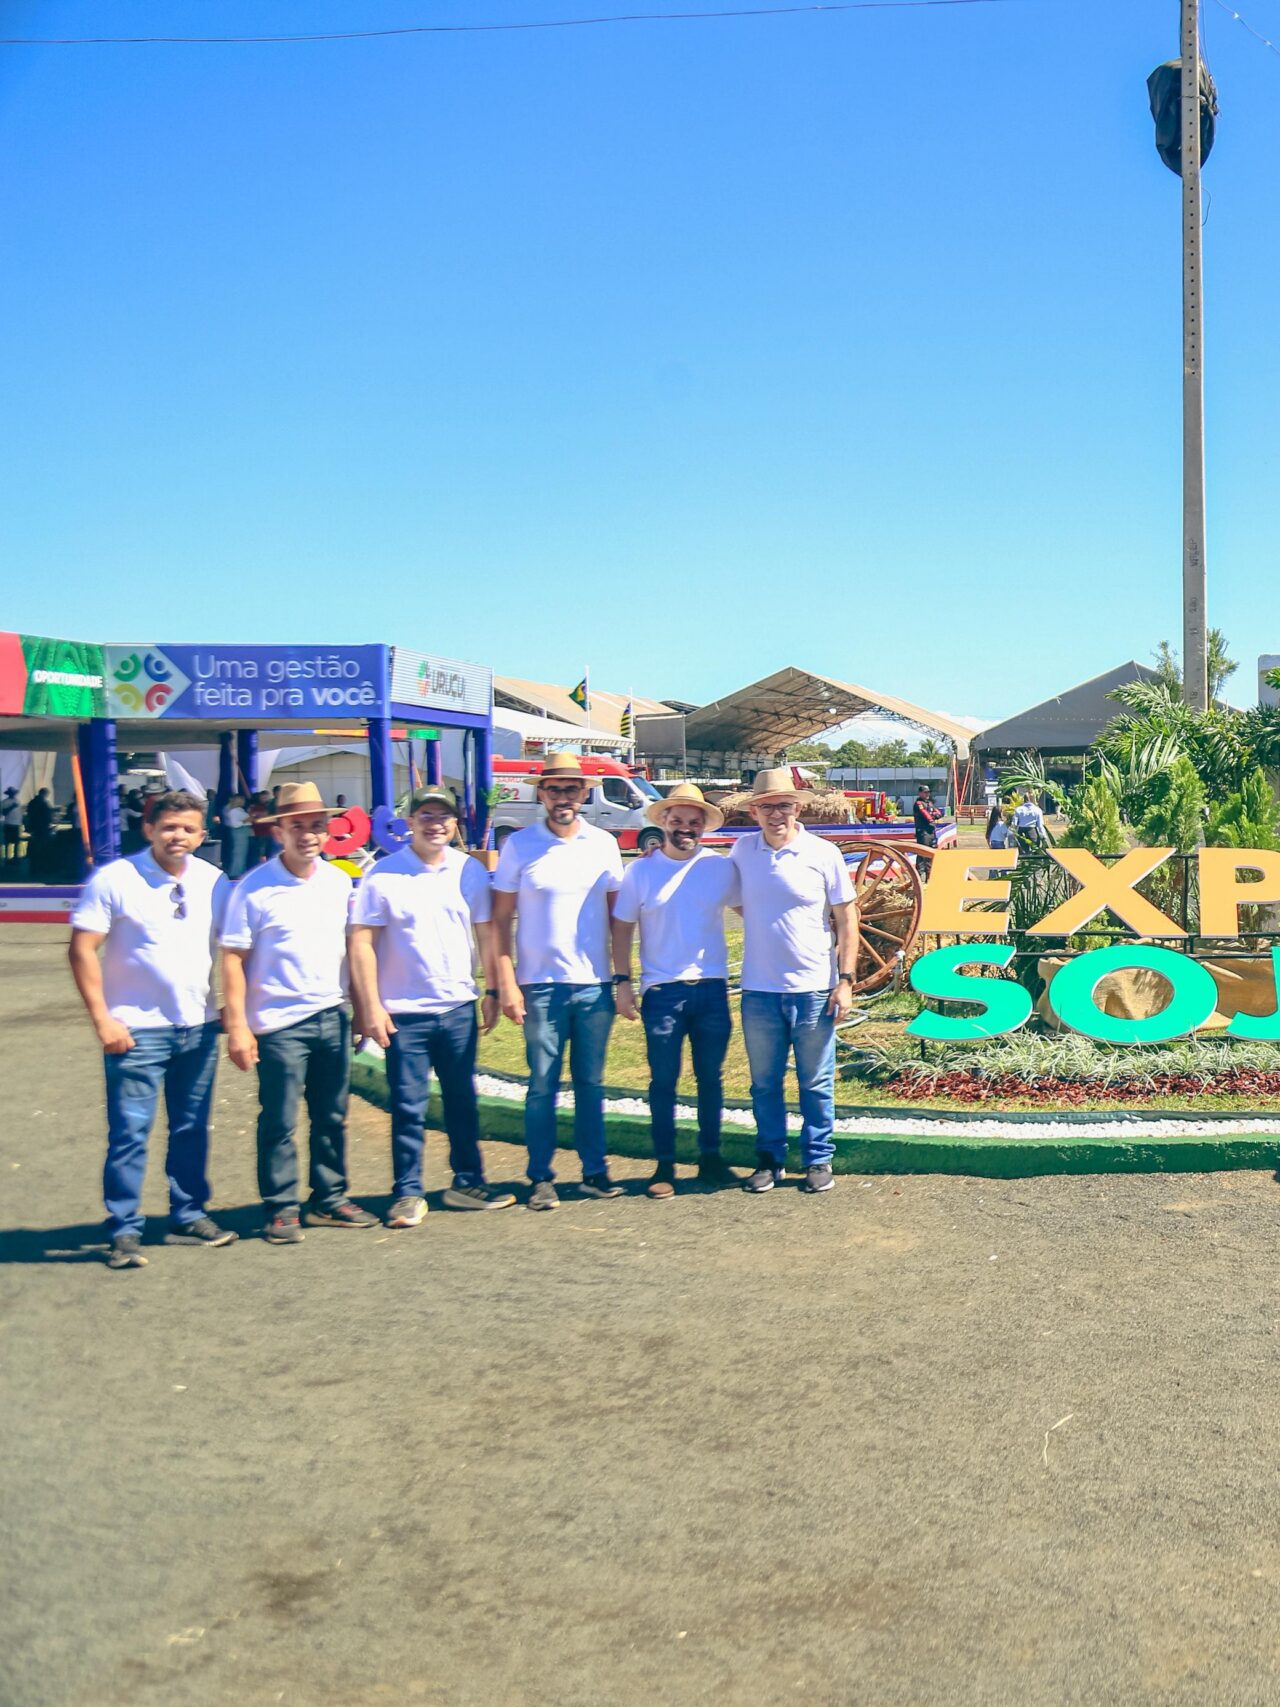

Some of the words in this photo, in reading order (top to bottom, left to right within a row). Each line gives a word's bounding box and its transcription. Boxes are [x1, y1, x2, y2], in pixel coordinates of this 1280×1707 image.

[193, 654, 258, 678] Uma
[267, 654, 361, 683] gestão
[193, 682, 252, 706] feita
[262, 688, 304, 711] pra
[311, 681, 382, 706] você.
